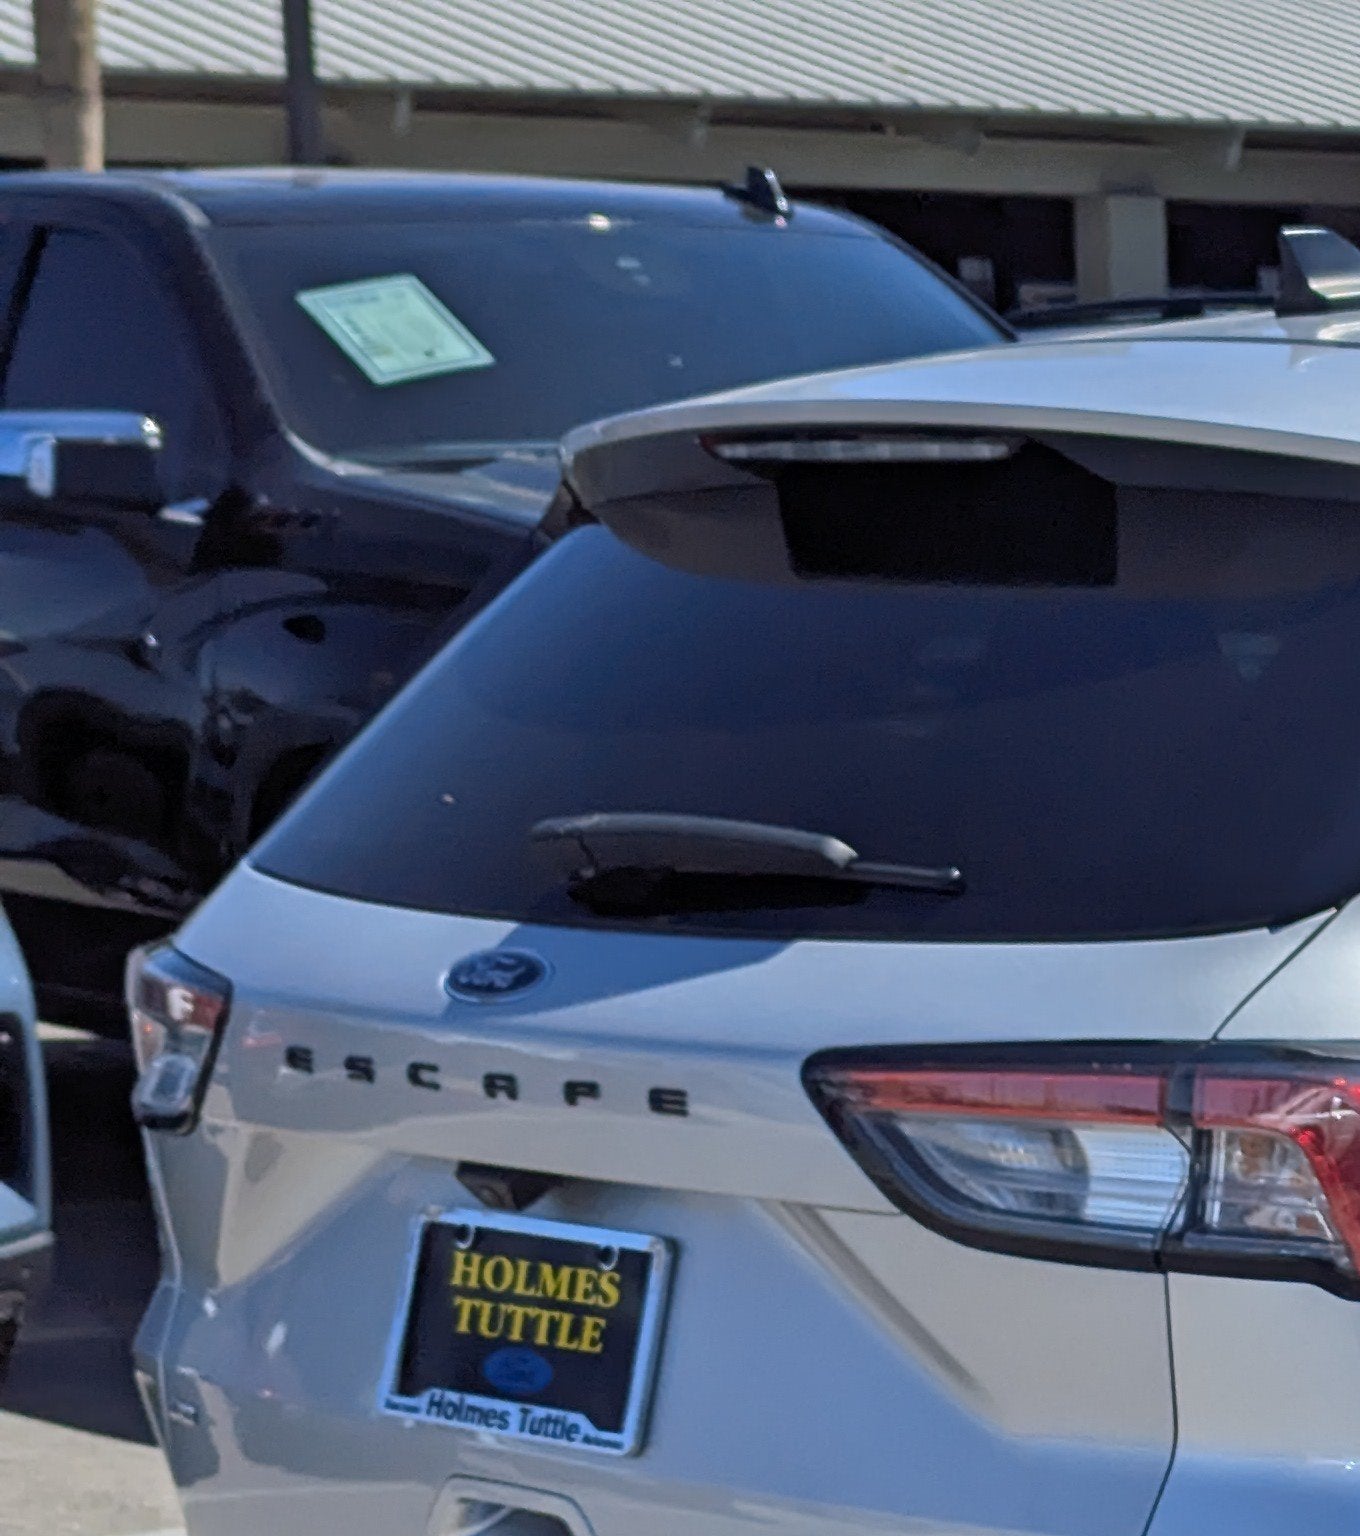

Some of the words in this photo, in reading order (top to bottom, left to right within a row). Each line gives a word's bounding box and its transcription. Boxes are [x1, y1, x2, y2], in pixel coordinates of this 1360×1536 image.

[285, 1045, 690, 1118] ESCAPE
[450, 1250, 622, 1309] HOLMES
[453, 1294, 607, 1354] TUTTLE
[425, 1391, 511, 1431] Holmes
[517, 1407, 582, 1442] Tuttle
